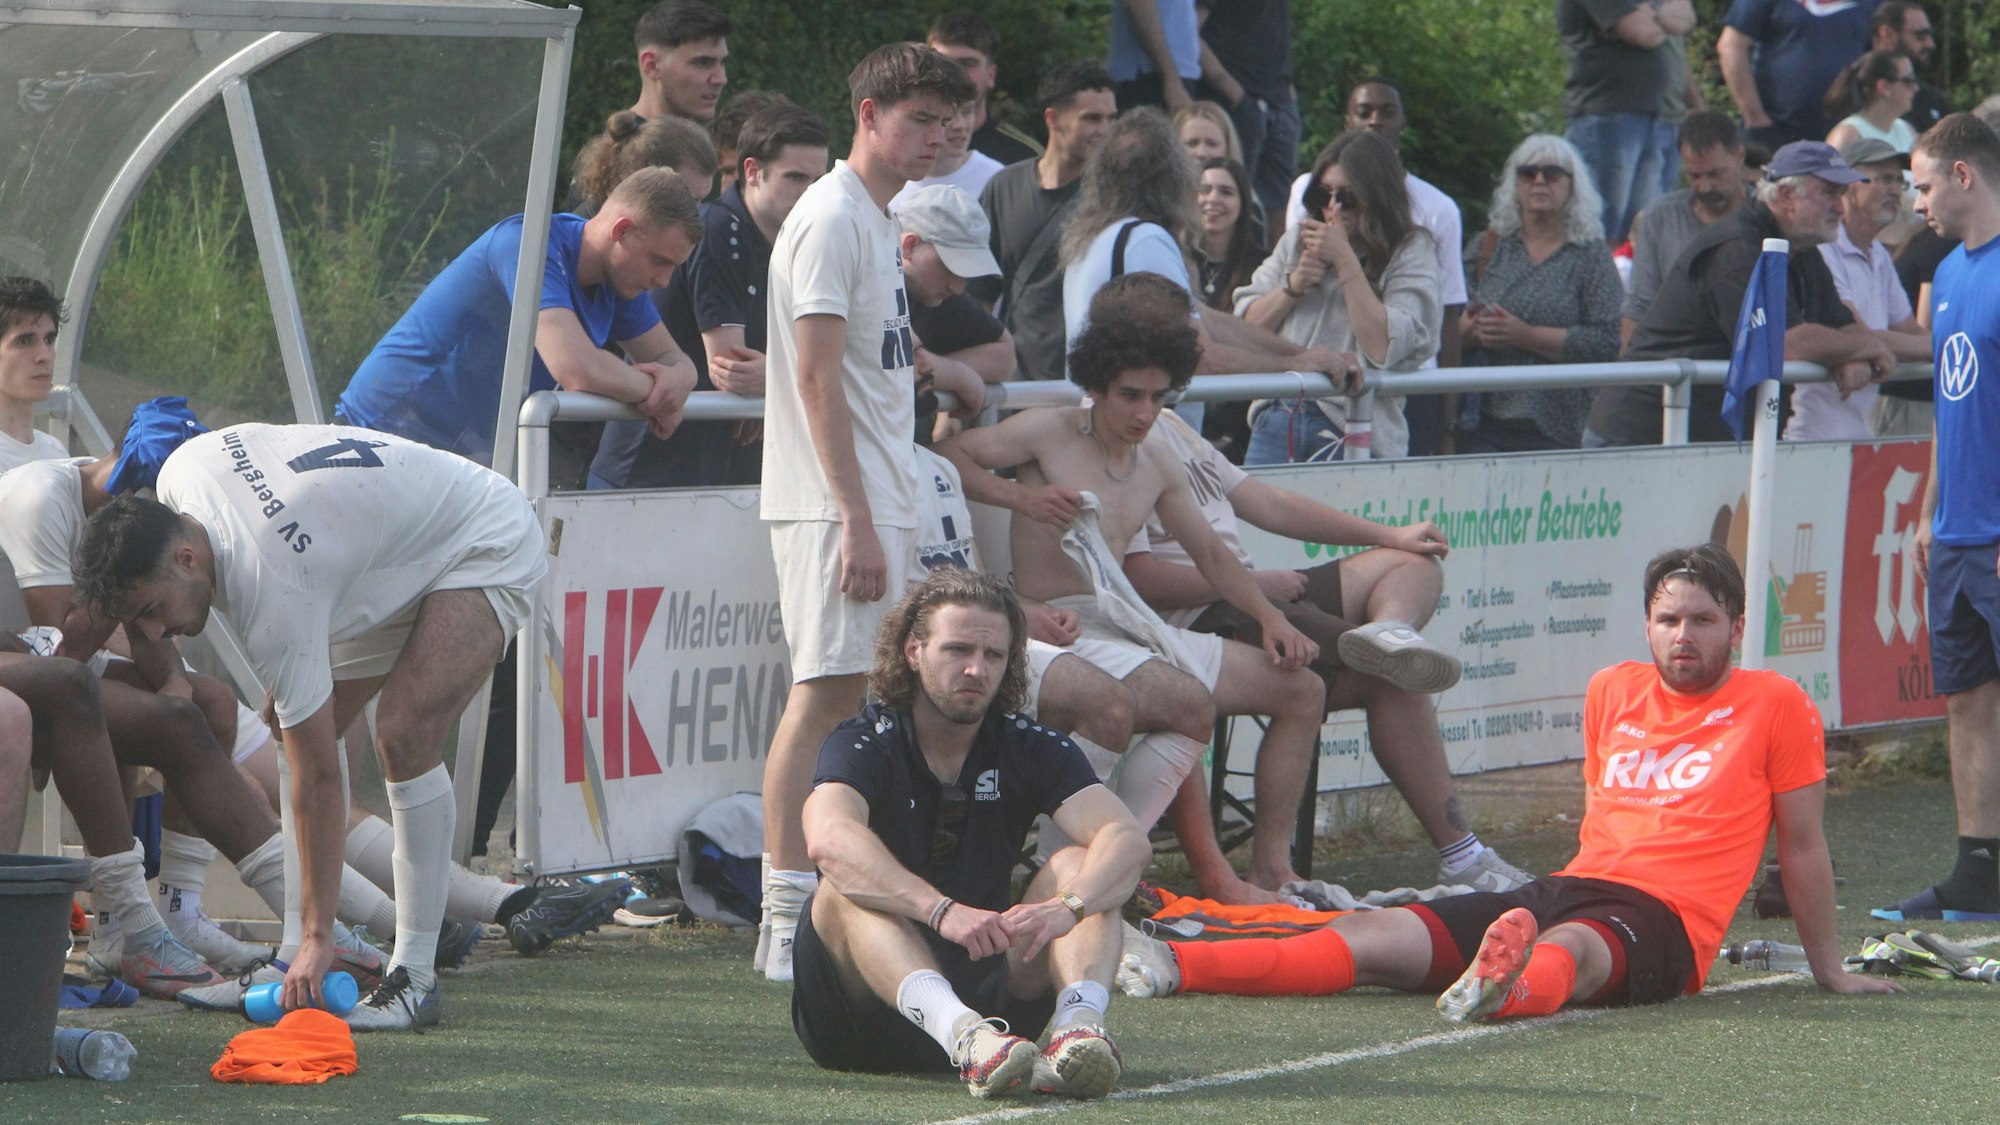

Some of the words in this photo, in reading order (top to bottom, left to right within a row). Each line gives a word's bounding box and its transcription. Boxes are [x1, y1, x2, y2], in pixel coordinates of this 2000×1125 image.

[286, 438, 390, 474] 4
[222, 432, 286, 519] Bergheim
[1536, 487, 1623, 543] Betriebe
[277, 521, 312, 553] SV
[1551, 579, 1612, 600] Pflasterarbeiten
[665, 588, 784, 651] Malerwe
[1464, 618, 1535, 648] Sabaggerarbeiten
[1463, 658, 1516, 681] Hauanschlüsse
[1898, 655, 1938, 702] KÖL
[1616, 722, 1647, 740] JAKO
[1603, 743, 1713, 790] RKG
[1618, 793, 1684, 806] www.rkg.de
